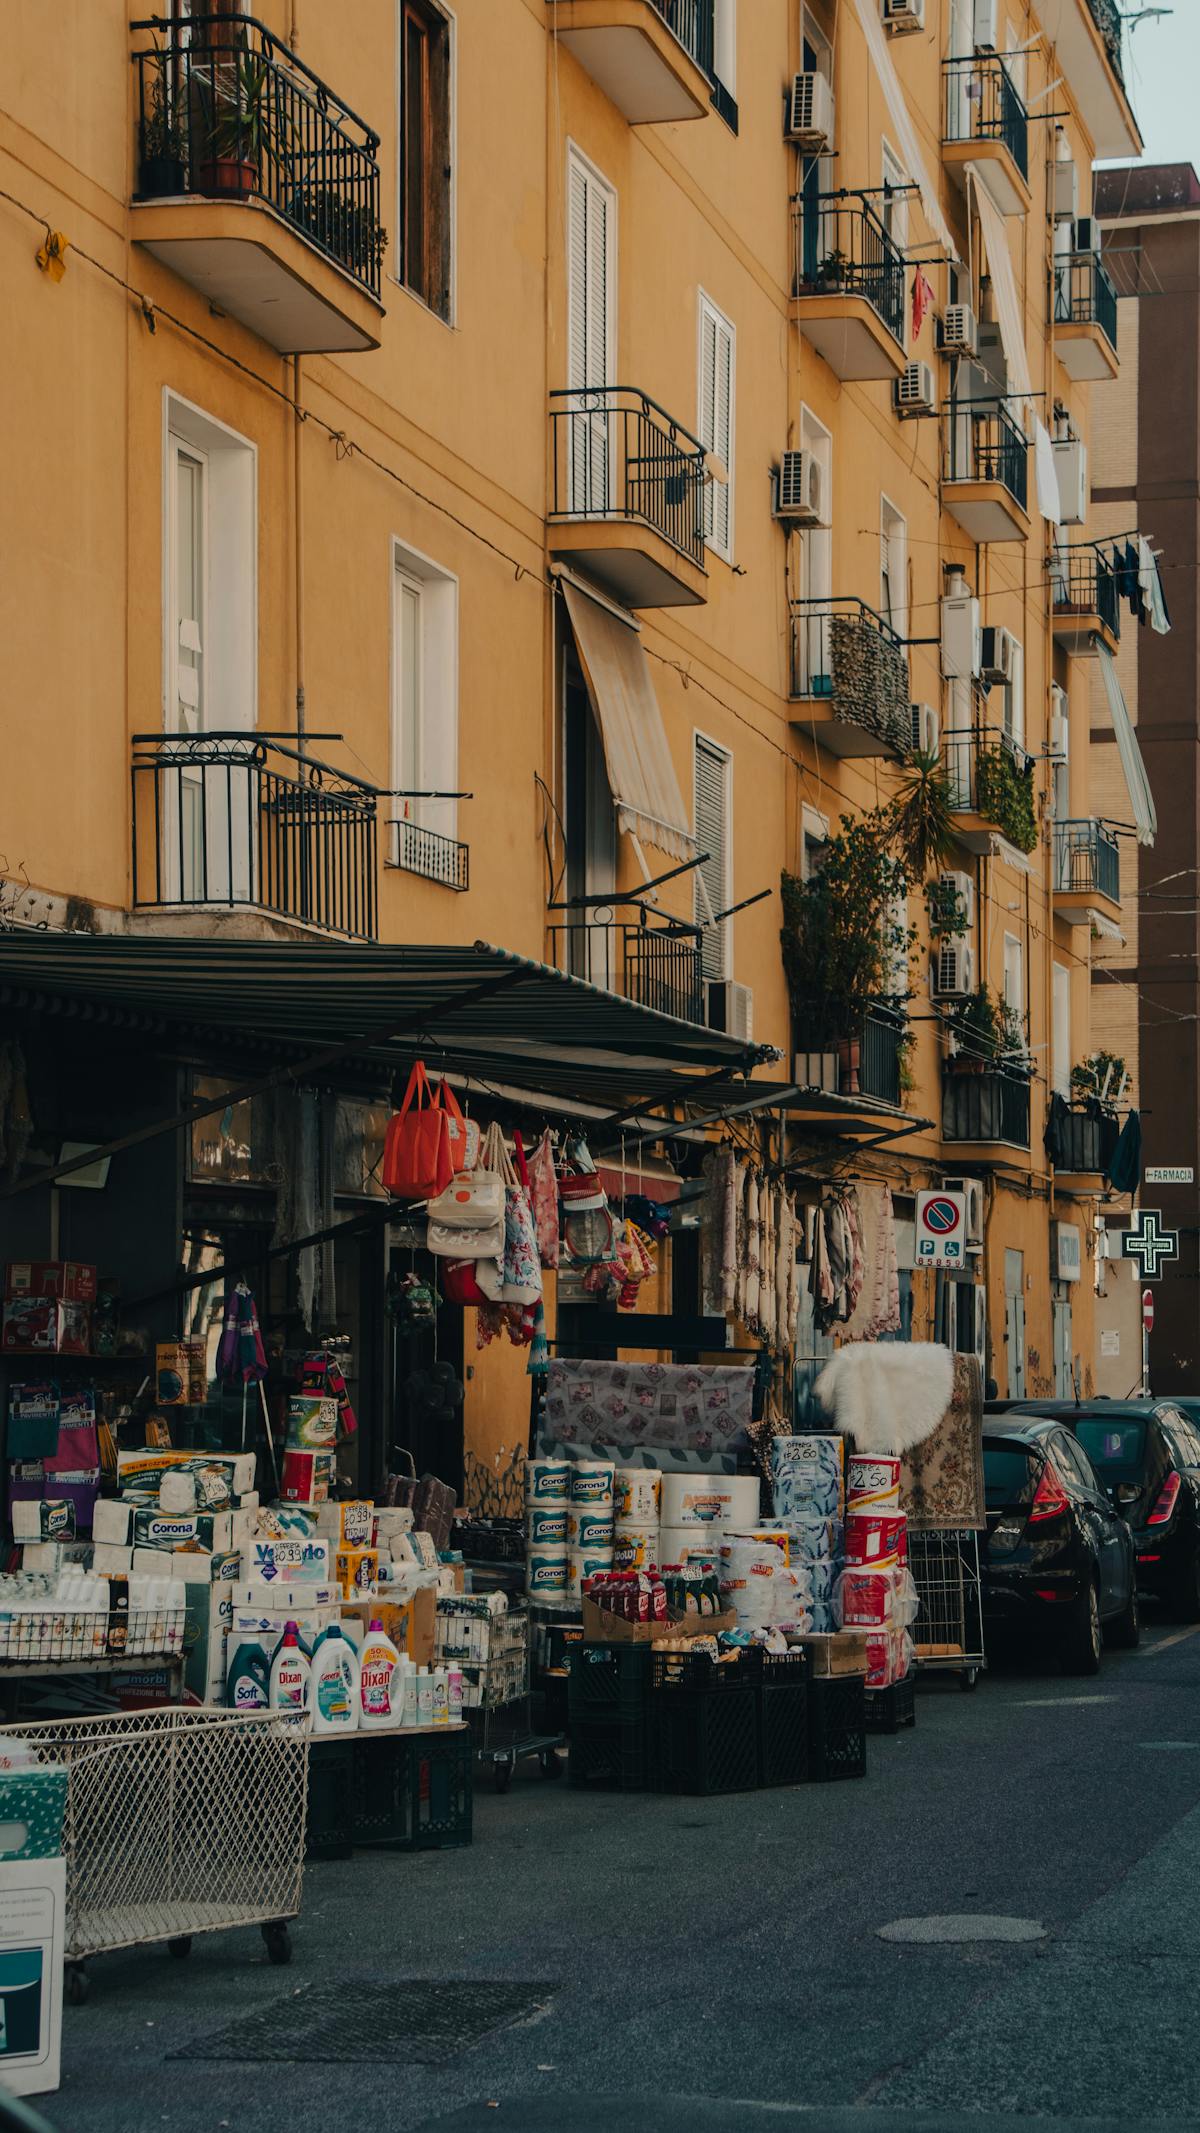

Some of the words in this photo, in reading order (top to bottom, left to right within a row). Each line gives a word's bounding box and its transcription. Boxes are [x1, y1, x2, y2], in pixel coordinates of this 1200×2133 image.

[1153, 1170, 1192, 1181] FARMACIA
[923, 1241, 933, 1254] P
[573, 1481, 606, 1491] Corona
[152, 1523, 193, 1534] Corona
[279, 1672, 302, 1684] Dixan
[361, 1671, 390, 1689] Dixan
[236, 1687, 258, 1699] Soft
